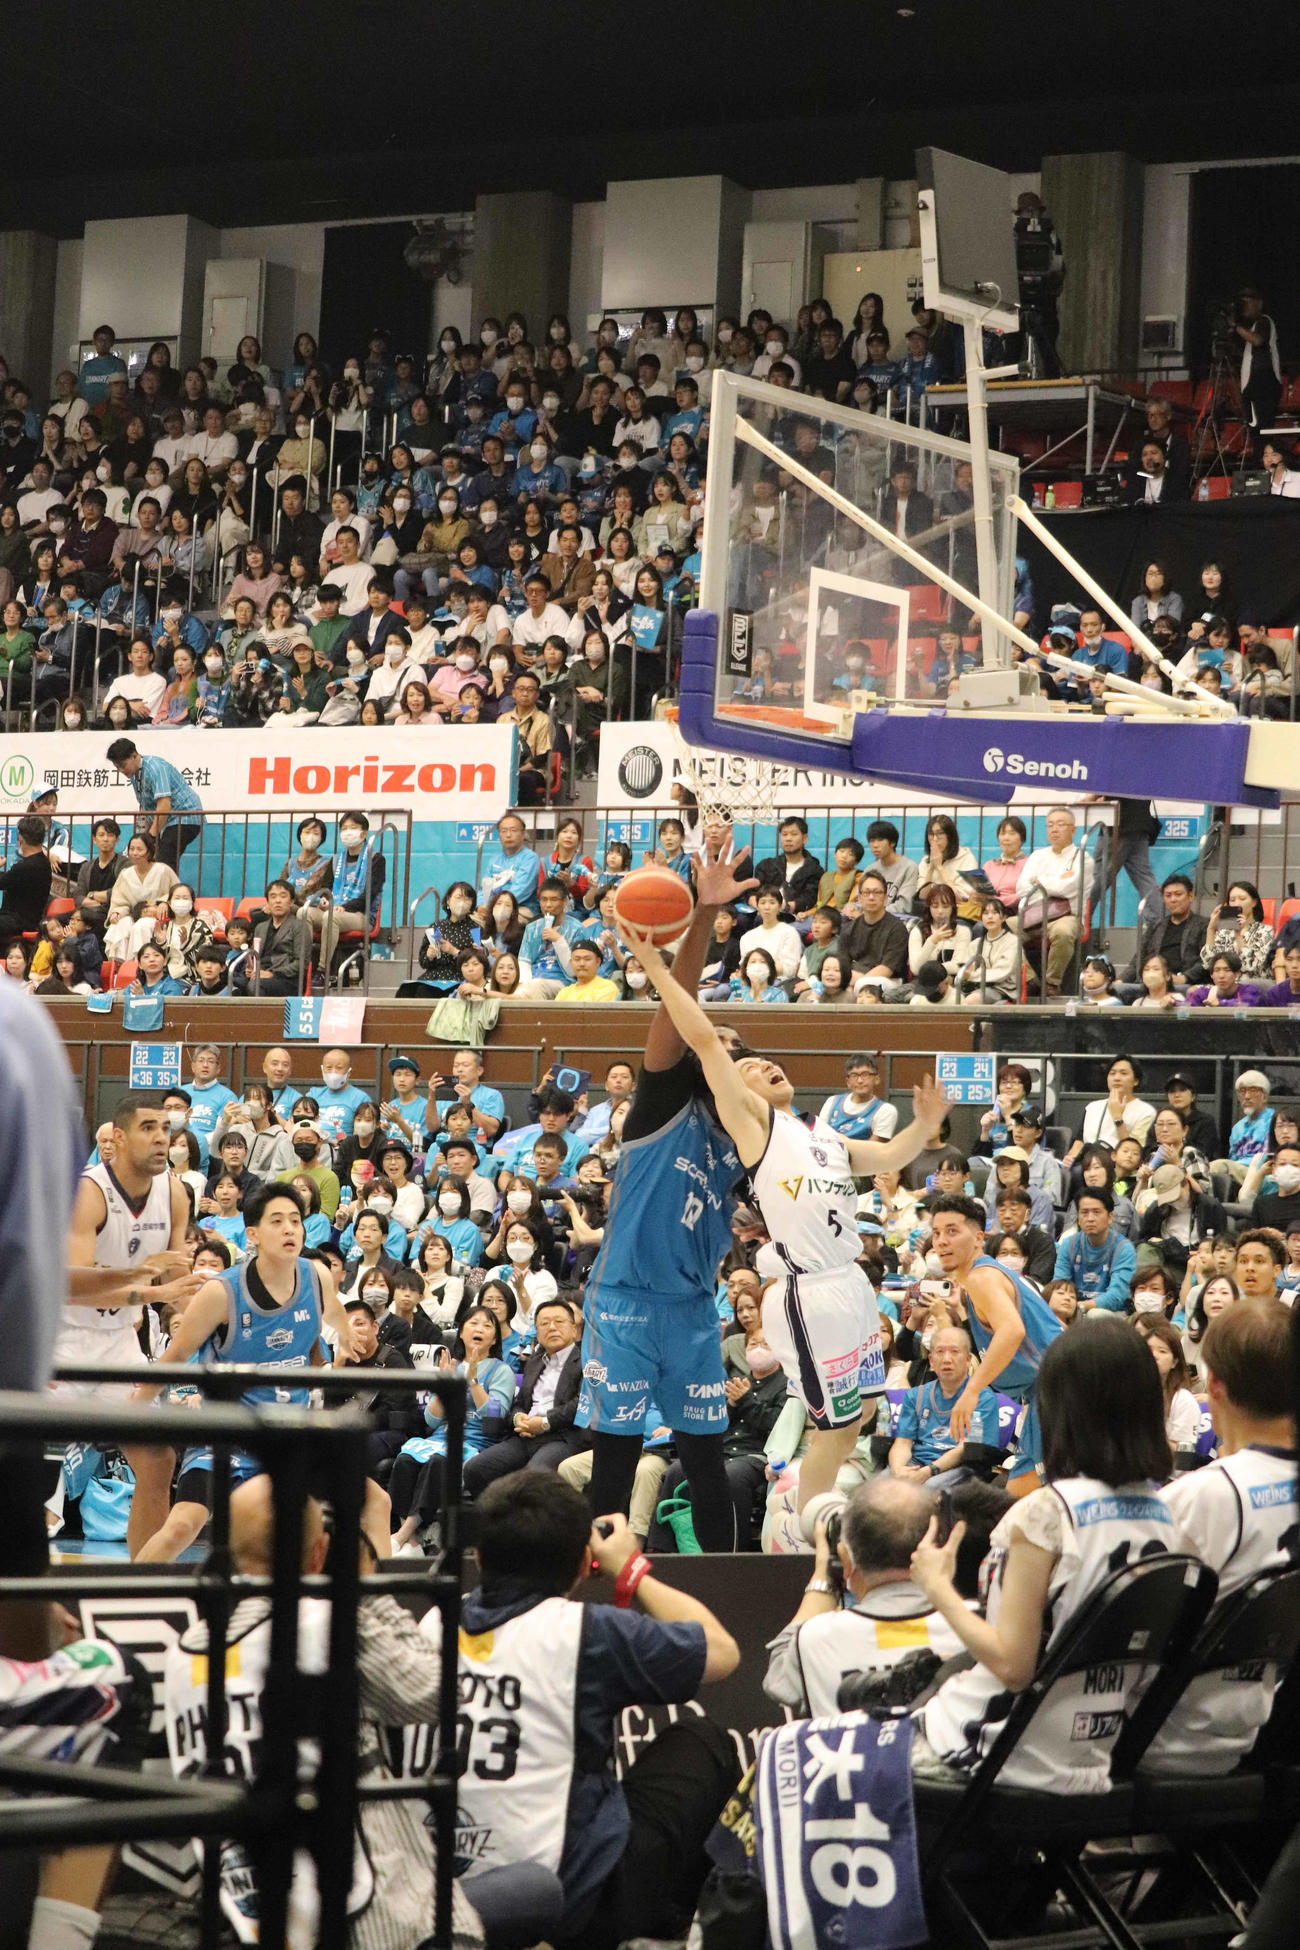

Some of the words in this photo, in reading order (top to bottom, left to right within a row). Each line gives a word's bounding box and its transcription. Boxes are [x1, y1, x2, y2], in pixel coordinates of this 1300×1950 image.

[621, 748, 660, 767] MEISTER
[248, 756, 496, 794] Horizon
[1006, 754, 1088, 780] Senoh
[620, 824, 642, 840] 325
[1164, 820, 1190, 837] 325
[136, 1050, 149, 1065] 22
[163, 1051, 176, 1065] 23
[942, 1062, 957, 1078] 23
[973, 1062, 989, 1078] 24
[140, 1071, 153, 1086] 36
[157, 1071, 170, 1086] 35
[947, 1084, 962, 1100] 26
[968, 1084, 983, 1100] 25
[828, 1209, 842, 1238] 5
[683, 1412, 705, 1420] STORE
[684, 1405, 705, 1413] DRUG
[777, 1740, 799, 1808] MORII
